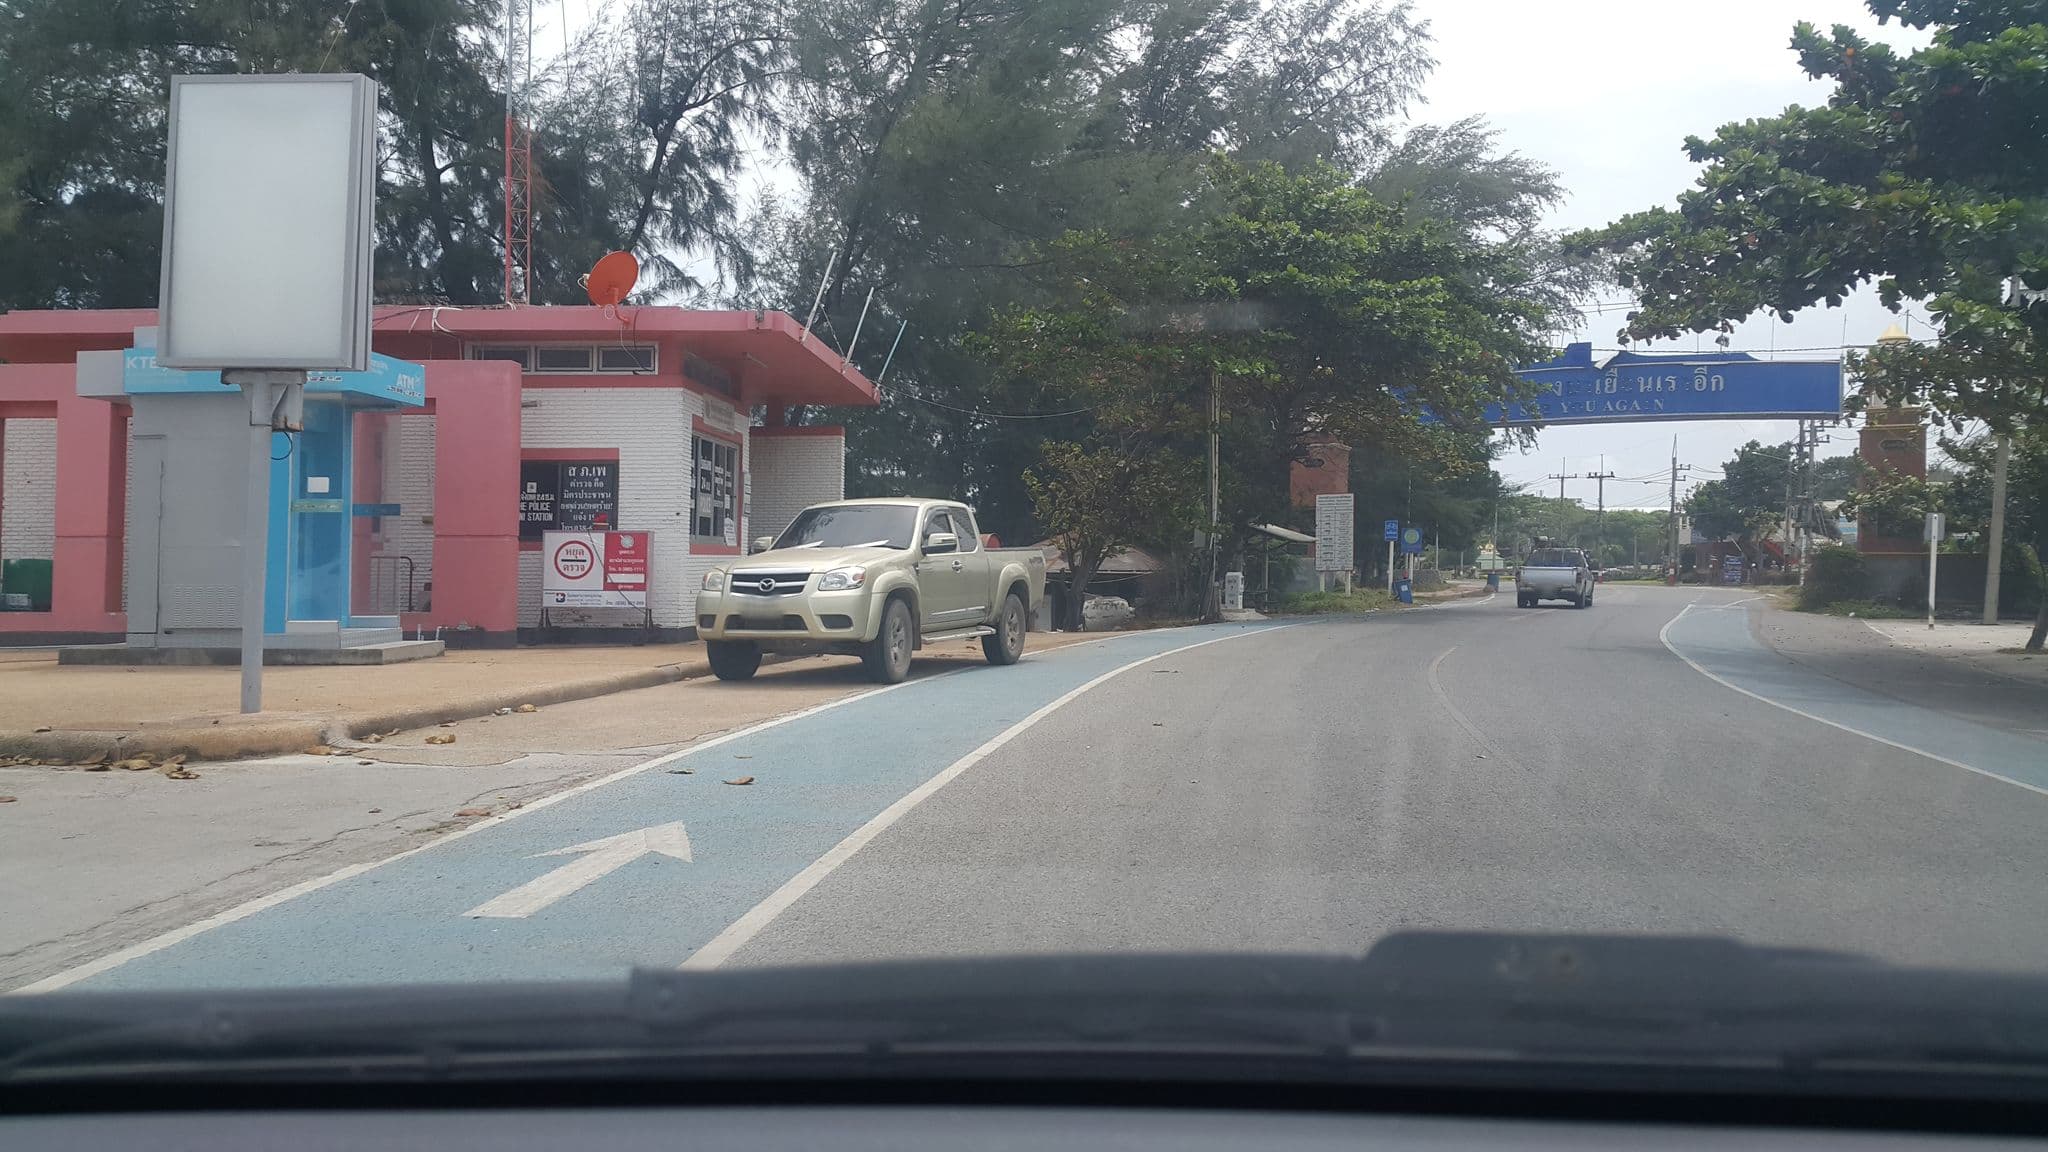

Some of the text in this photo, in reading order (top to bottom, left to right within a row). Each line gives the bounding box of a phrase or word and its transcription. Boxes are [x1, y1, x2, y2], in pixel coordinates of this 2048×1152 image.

[397, 372, 415, 390] ATM
[528, 502, 551, 511] POLICE
[527, 512, 553, 521] STATION
[564, 548, 585, 559] หยุด
[563, 564, 585, 573] ตรวจ
